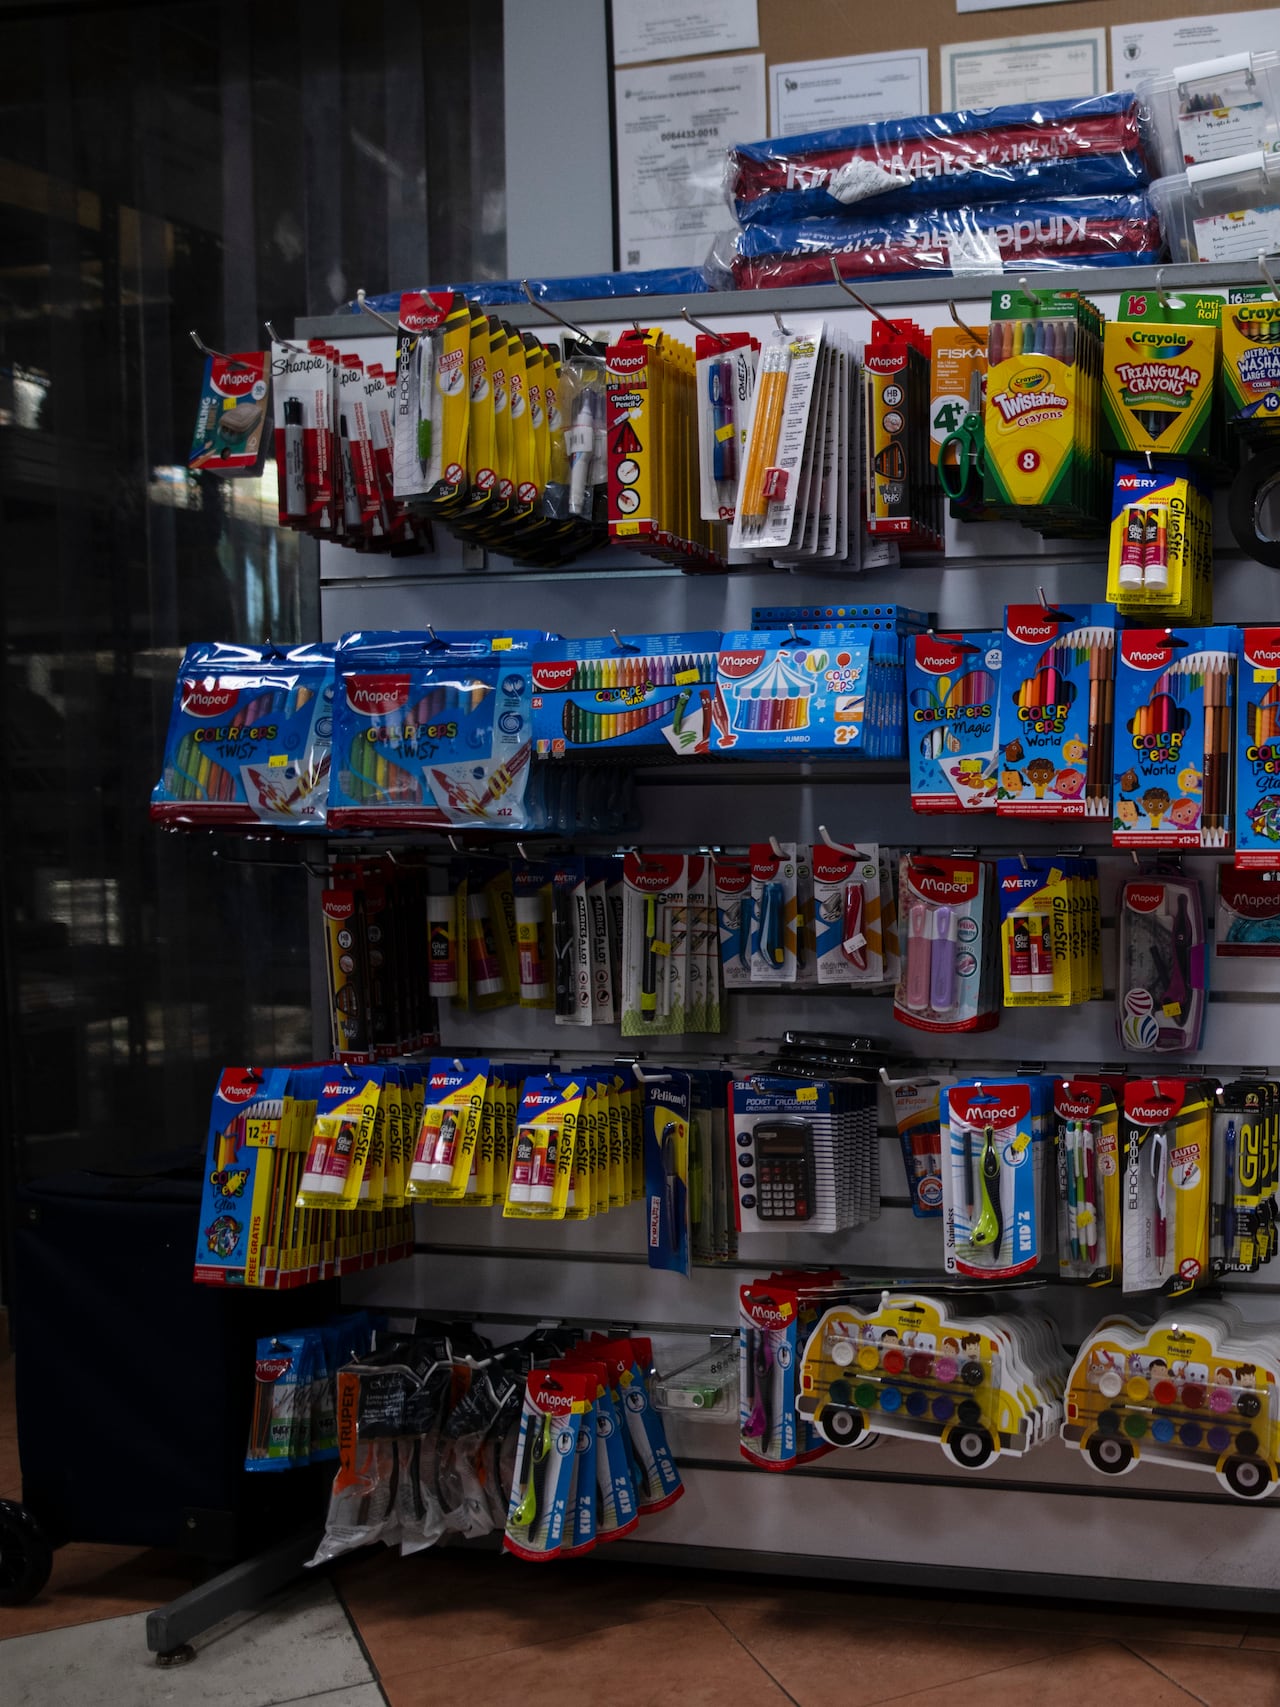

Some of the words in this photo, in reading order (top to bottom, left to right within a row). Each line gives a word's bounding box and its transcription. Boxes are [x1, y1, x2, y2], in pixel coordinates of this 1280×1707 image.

[784, 150, 970, 190] KinrMats
[999, 294, 1012, 310] 8
[1127, 295, 1147, 316] 16
[1195, 299, 1223, 311] Anti-
[1231, 293, 1243, 304] 16
[404, 313, 440, 327] Maped
[1197, 309, 1218, 320] Roll
[1132, 331, 1187, 347] Crayola
[441, 350, 463, 365] AUTO
[610, 355, 644, 367] Maped
[869, 355, 904, 367] Maped
[272, 356, 327, 377] Sharpie
[218, 371, 256, 386] Maped
[1015, 372, 1044, 387] Crayola
[1117, 364, 1200, 386] TRIANGULAR
[1242, 369, 1265, 382] LARGE
[1129, 377, 1185, 395] CRAYONS
[611, 394, 641, 402] Checking
[887, 390, 898, 398] HB
[616, 400, 635, 408] Pencil
[993, 391, 1067, 422] Twistables
[1265, 397, 1278, 408] 16
[196, 396, 211, 440] SMILING
[1018, 409, 1063, 428] Crayons
[1023, 453, 1035, 470] 8
[1116, 478, 1157, 488] AVERY
[1169, 497, 1185, 561] GlueStic
[1015, 625, 1051, 637] Maped
[720, 653, 761, 668] Maped
[923, 656, 957, 668] Maped
[1129, 650, 1165, 662] Maped
[536, 666, 574, 682] Maped
[826, 680, 855, 693] PEPS
[189, 692, 231, 706] Maped
[353, 689, 400, 704] Maped
[626, 694, 645, 707] WAX
[1017, 703, 1070, 721] COLOR'
[835, 727, 858, 744] 2+
[952, 721, 992, 738] Magic
[784, 735, 811, 743] JUMBO
[1026, 735, 1062, 747] World
[1132, 731, 1185, 750] COLOR'
[216, 742, 258, 760] TWIST
[396, 742, 439, 761] TWIST
[1141, 764, 1177, 776] World
[300, 806, 316, 816] x12
[1062, 805, 1083, 815] x12+3
[1178, 835, 1200, 845] x12+3
[753, 864, 775, 874] Maped
[817, 865, 848, 875] Maped
[514, 875, 545, 883] AVERY
[553, 874, 578, 883] AVERY
[635, 875, 670, 886] Maped
[719, 876, 746, 886] Maped
[1001, 879, 1038, 889] AVERY
[920, 878, 968, 895] Maped
[657, 892, 683, 905] Gom
[1130, 893, 1160, 904] Maped
[1233, 893, 1280, 908] Maped
[325, 902, 351, 913] Maped
[577, 899, 588, 938] MARKS
[593, 899, 605, 937] MARKS
[1052, 896, 1069, 961] GlueStic
[431, 941, 448, 951] Glue
[580, 948, 588, 965] LOT
[598, 947, 606, 965] LOT
[430, 1077, 462, 1086] AVERY
[224, 1085, 252, 1096] Maped
[322, 1085, 356, 1095] AVERY
[523, 1096, 557, 1104] AVERY
[746, 1098, 771, 1106] POCKET
[775, 1098, 817, 1106] CALCULATOR
[965, 1106, 1019, 1121] Maped
[1059, 1102, 1092, 1114] Maped
[1131, 1107, 1171, 1117] Maped
[261, 1122, 271, 1130] +1
[462, 1094, 482, 1155] GlueStic
[482, 1101, 494, 1162] GlueStic
[248, 1127, 260, 1139] 12
[353, 1104, 375, 1166] GlueStic
[389, 1103, 401, 1164] GlueStic
[609, 1106, 621, 1165] GlueStic
[631, 1103, 643, 1162] GlueStic
[260, 1136, 268, 1145] +1
[557, 1112, 576, 1175] GlueStic
[577, 1114, 588, 1176] GlueStic
[1098, 1135, 1116, 1147] LONG
[1173, 1145, 1199, 1158] AUTO
[1104, 1161, 1111, 1169] 2
[1171, 1154, 1201, 1167] NO-CLICK
[1129, 1167, 1138, 1210] BLACK
[947, 1208, 956, 1249] Stainless
[1018, 1210, 1031, 1251] KID'Z
[250, 1216, 261, 1257] GRATIS
[947, 1257, 955, 1269] 5
[1224, 1263, 1252, 1271] PILOT
[247, 1258, 257, 1284] FREE
[256, 1361, 288, 1372] Maped
[535, 1390, 575, 1407] Maped
[342, 1382, 355, 1451] TRUPER
[784, 1411, 794, 1450] KID'Z
[655, 1447, 676, 1484] KID'Z
[615, 1476, 632, 1514] KID'Z
[551, 1500, 564, 1540] KID'Z
[580, 1496, 591, 1535] KID'Z
